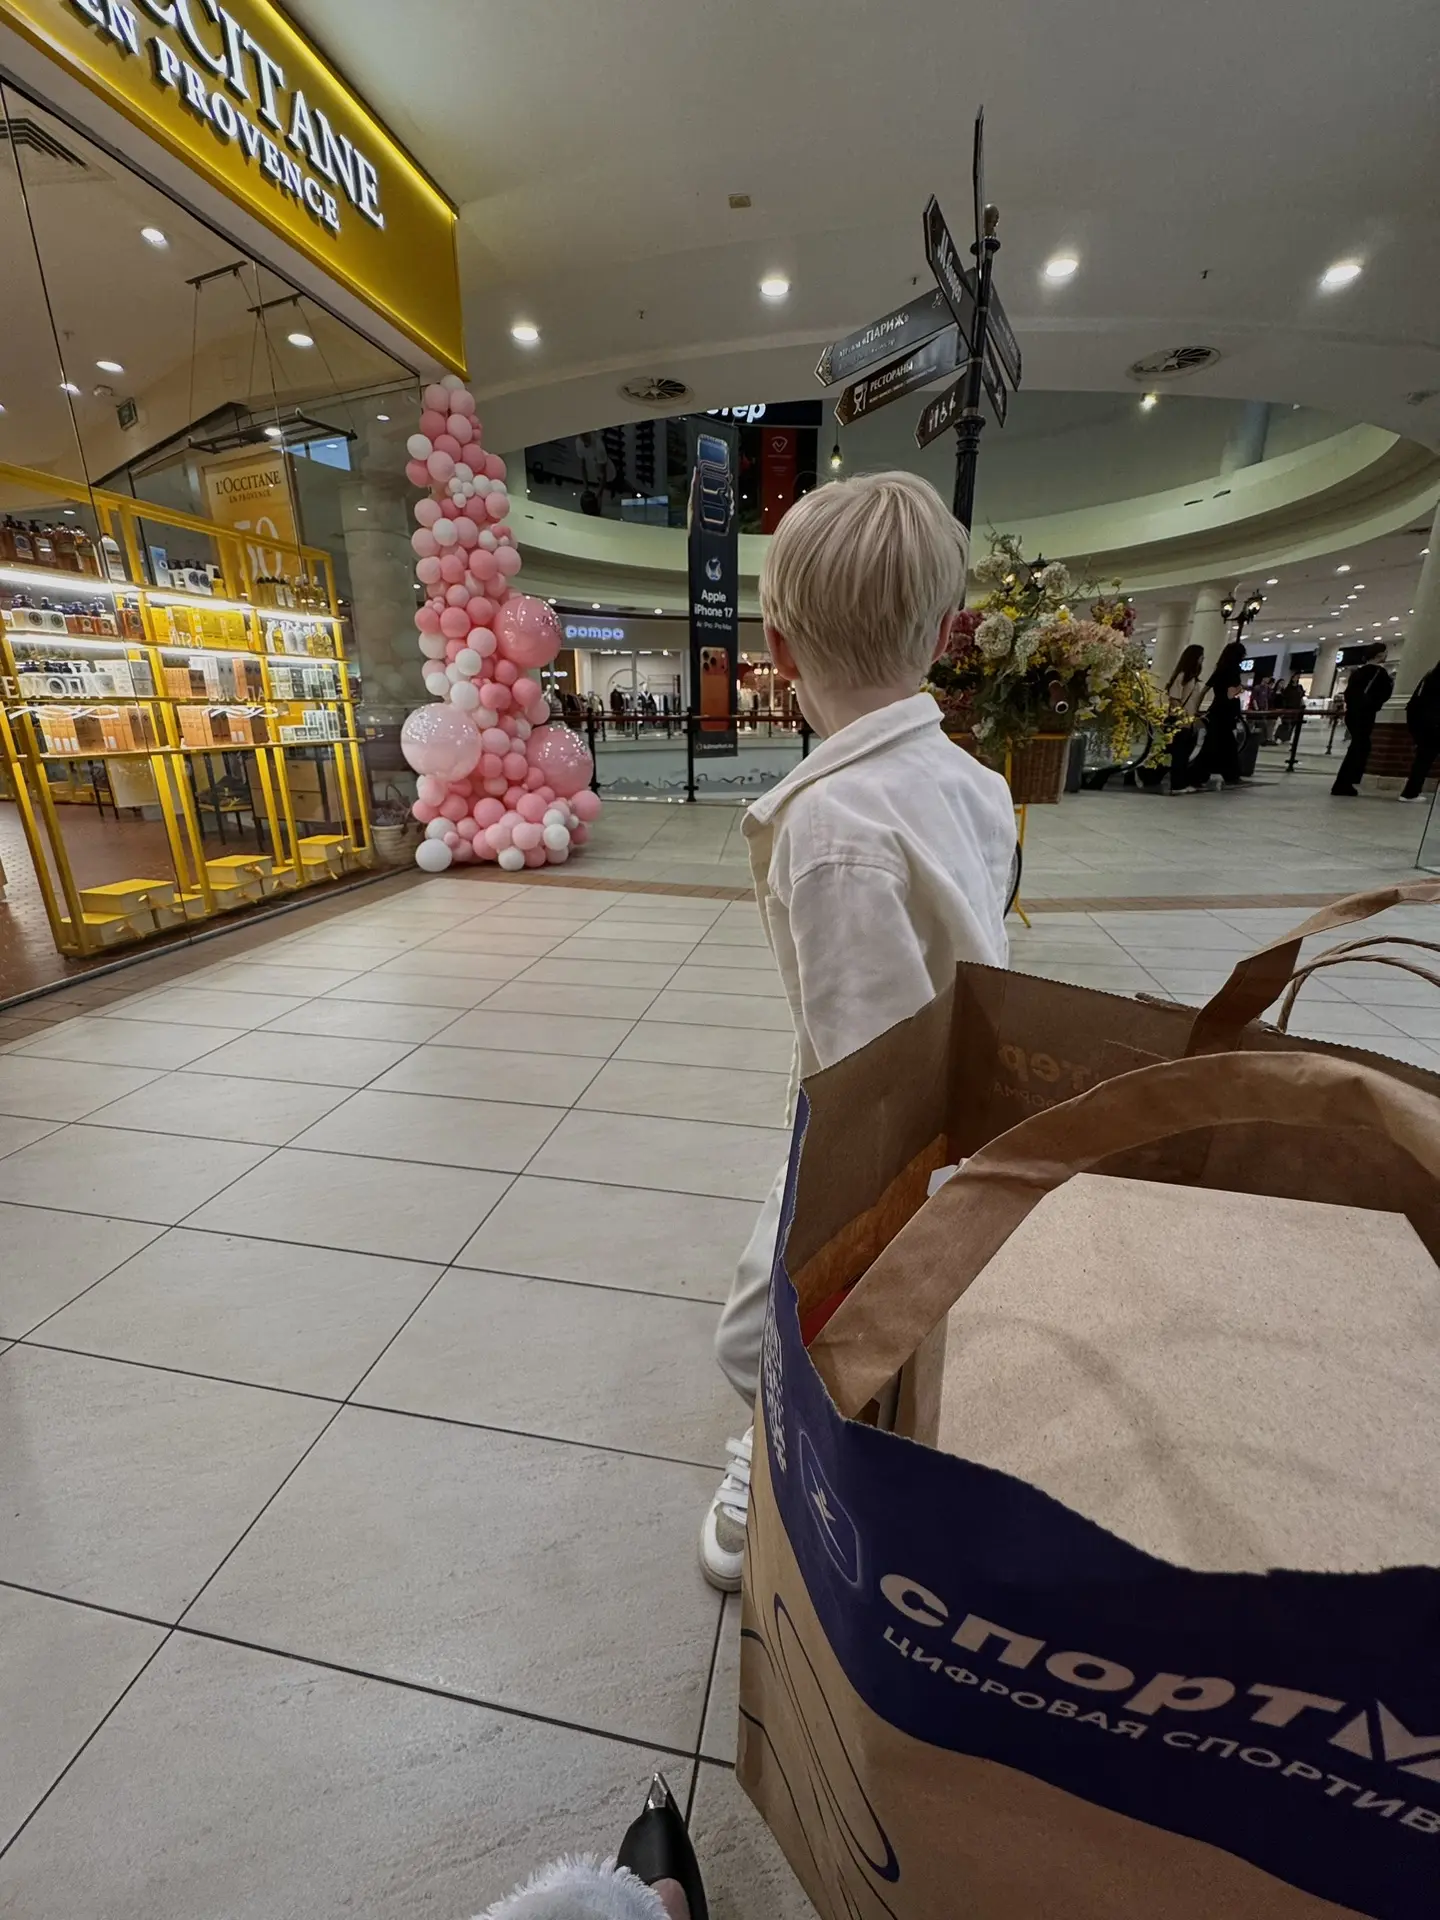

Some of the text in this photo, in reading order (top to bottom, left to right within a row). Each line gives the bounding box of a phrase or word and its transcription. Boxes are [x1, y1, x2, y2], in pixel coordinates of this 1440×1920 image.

[138, 0, 385, 230] CITANE
[154, 35, 341, 231] PROVENCE
[869, 360, 914, 392] РЕСТОРАНЫ
[215, 470, 282, 495] L'OCCITANE
[693, 603, 734, 619] iPhone 17
[700, 589, 727, 604] Apple
[883, 1625, 1149, 1740] ЦИФРОВАЯ
